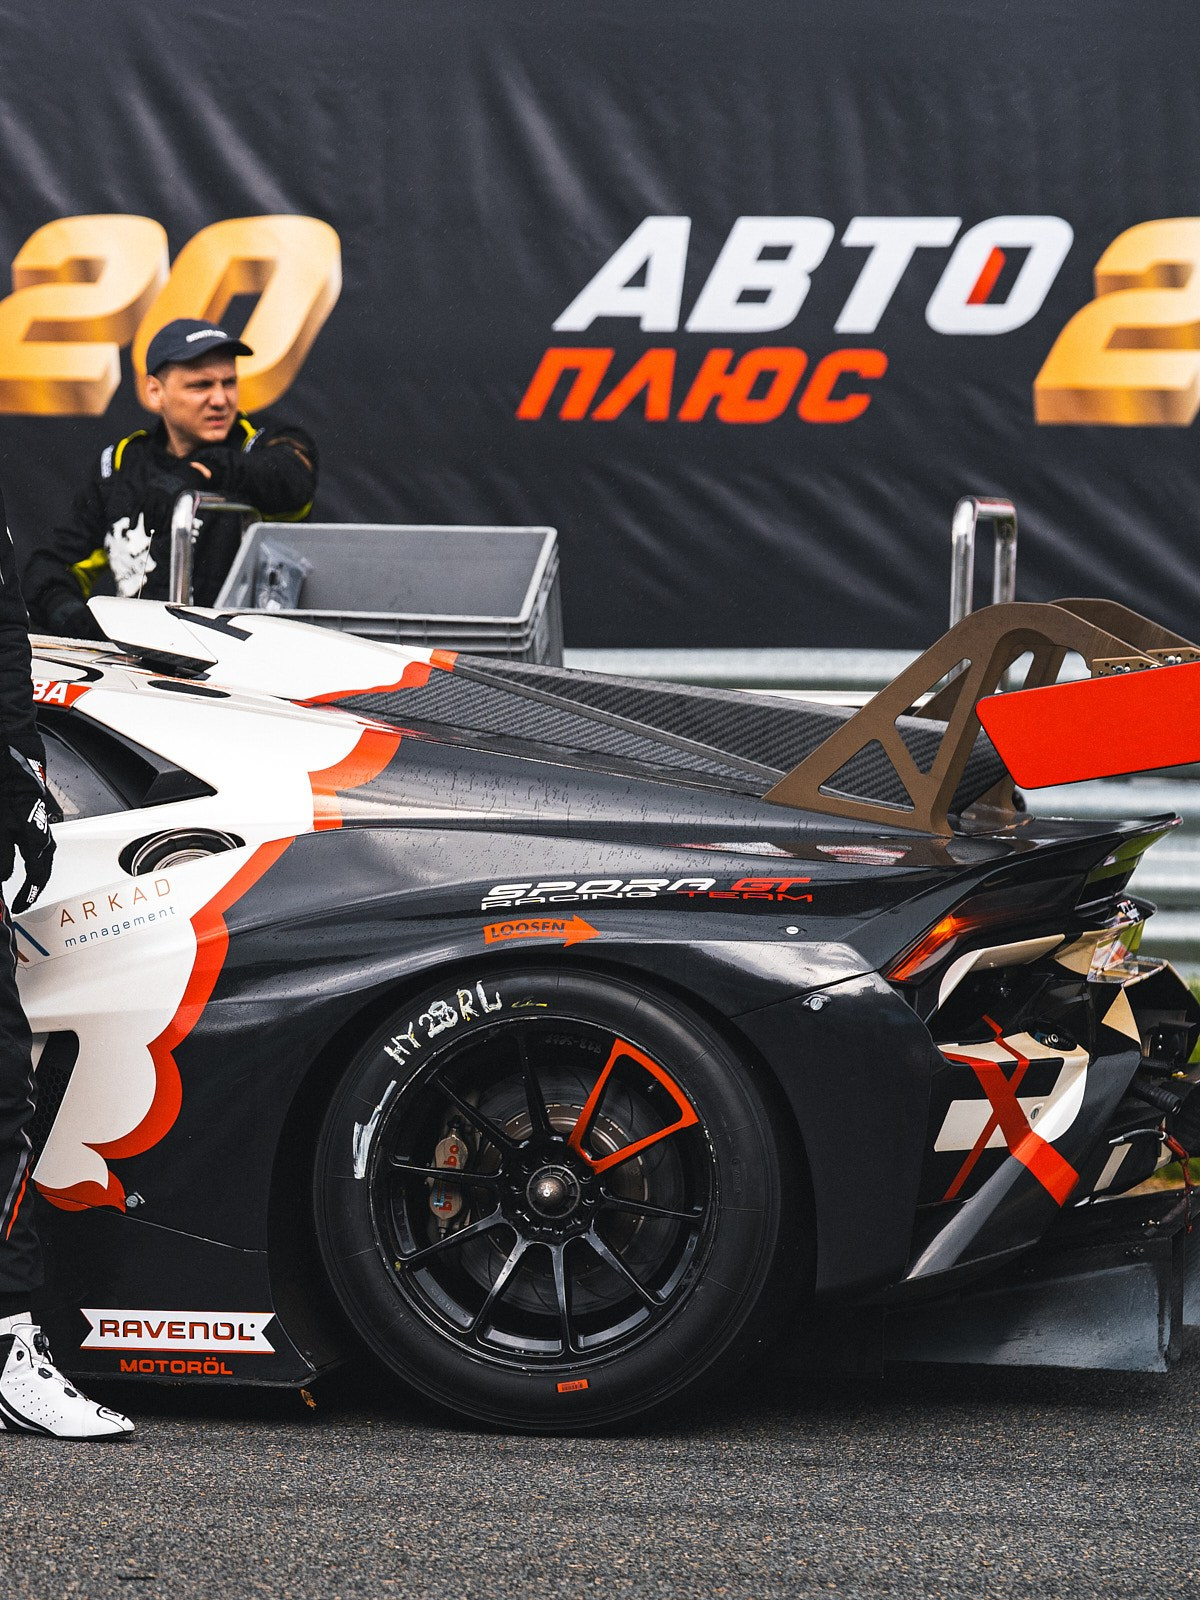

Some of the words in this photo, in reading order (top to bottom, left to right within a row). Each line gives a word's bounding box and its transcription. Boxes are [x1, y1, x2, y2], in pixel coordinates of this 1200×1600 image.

[552, 215, 1074, 336] АВТО
[1033, 218, 1200, 427] 2
[515, 347, 888, 424] ПЛЮС
[486, 877, 718, 898] SPORA
[729, 877, 812, 893] GT
[59, 877, 172, 929] ARKAD
[480, 891, 658, 911] RACING
[675, 890, 814, 903] TEAM
[64, 905, 176, 949] management
[489, 918, 566, 938] LOOSEN
[99, 1318, 256, 1343] RAVENOL
[119, 1356, 234, 1376] MOTORÖL
